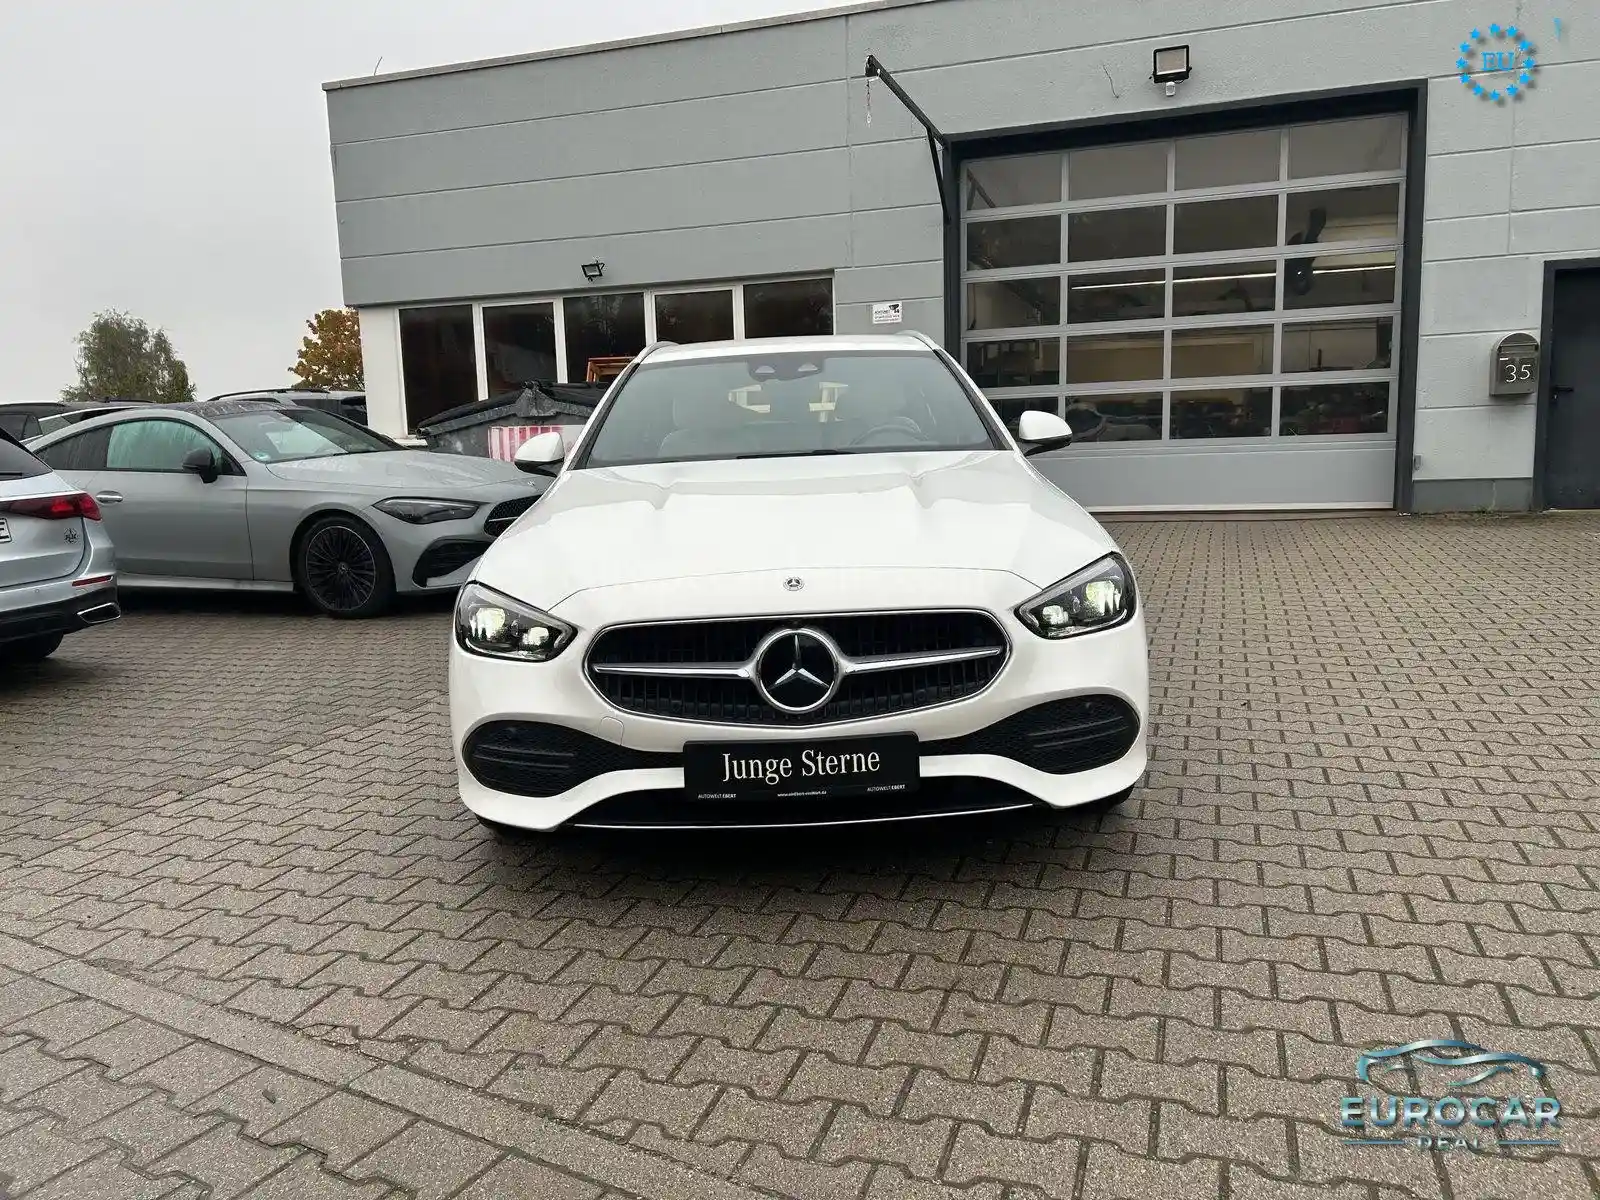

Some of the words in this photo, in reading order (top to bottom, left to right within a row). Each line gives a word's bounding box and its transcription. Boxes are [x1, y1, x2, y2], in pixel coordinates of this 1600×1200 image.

[1505, 364, 1531, 383] 35
[722, 753, 793, 785] Junge
[801, 749, 880, 777] Sterne
